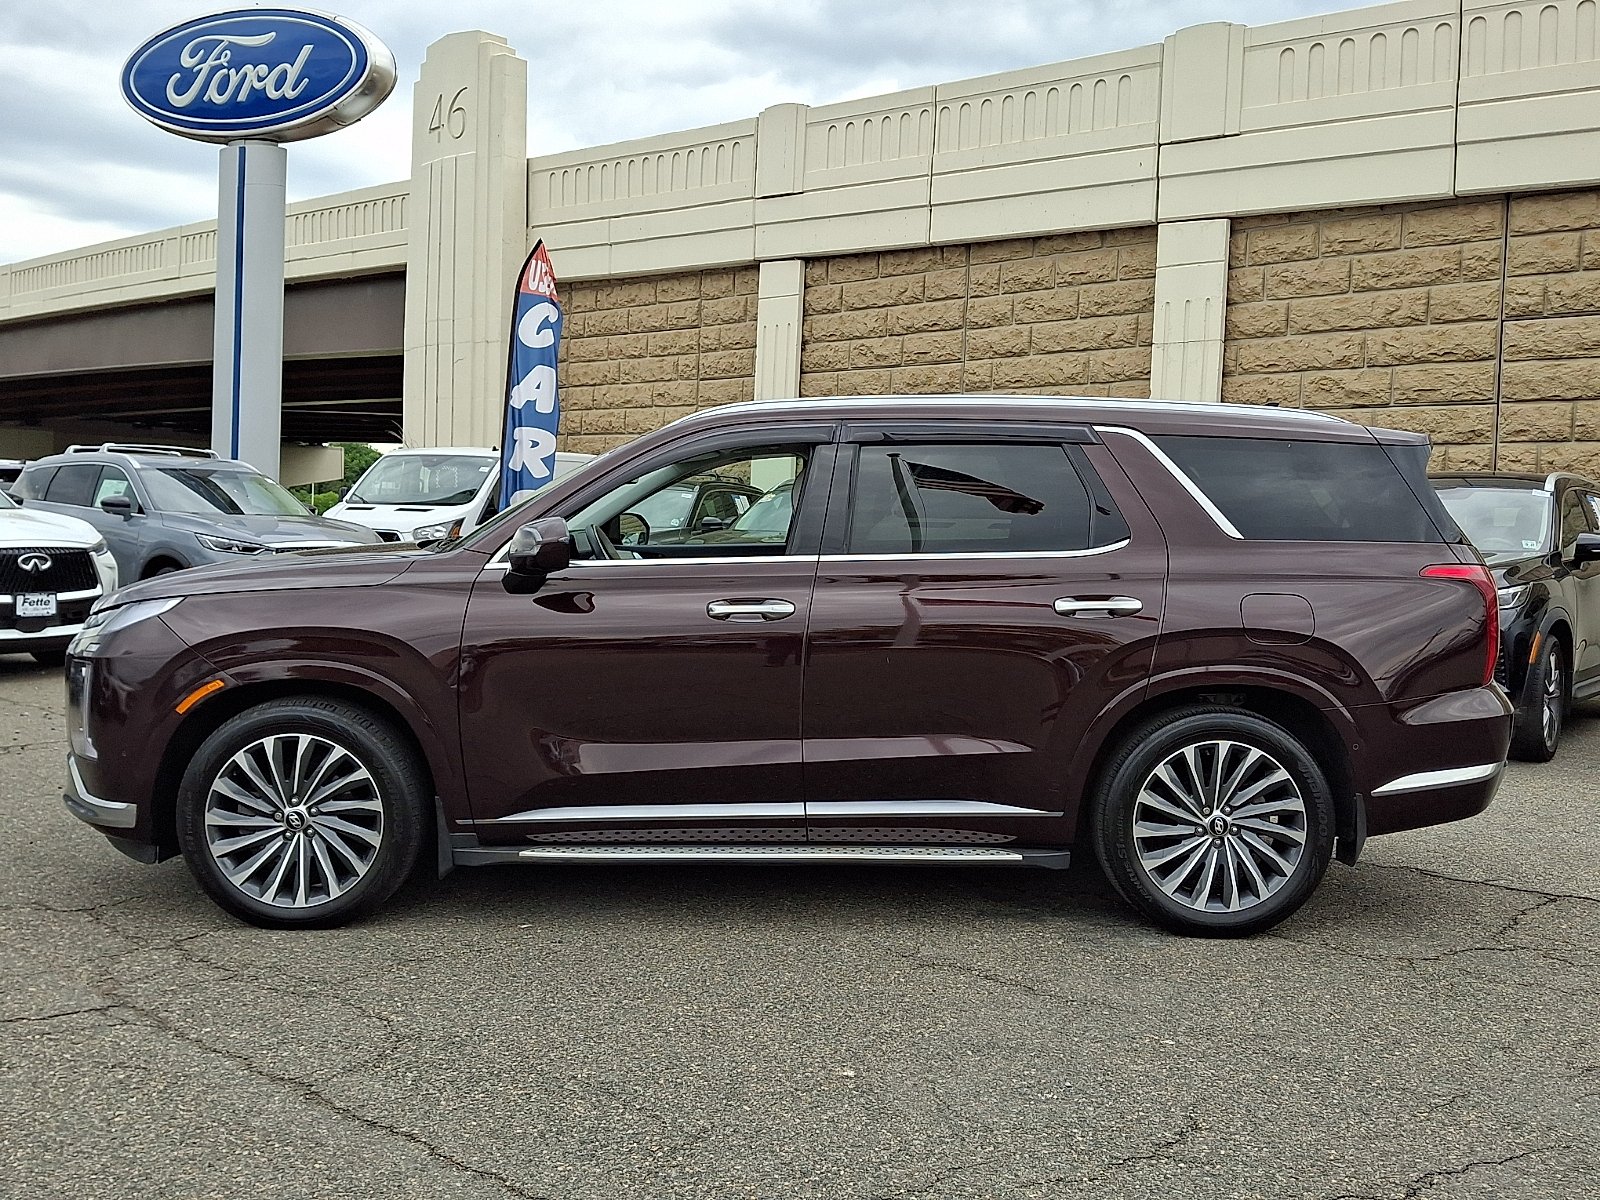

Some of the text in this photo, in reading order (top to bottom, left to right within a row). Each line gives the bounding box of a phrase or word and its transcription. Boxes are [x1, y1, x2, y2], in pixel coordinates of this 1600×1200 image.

[166, 31, 314, 108] Ford
[428, 86, 468, 143] 46
[21, 597, 51, 607] Fette
